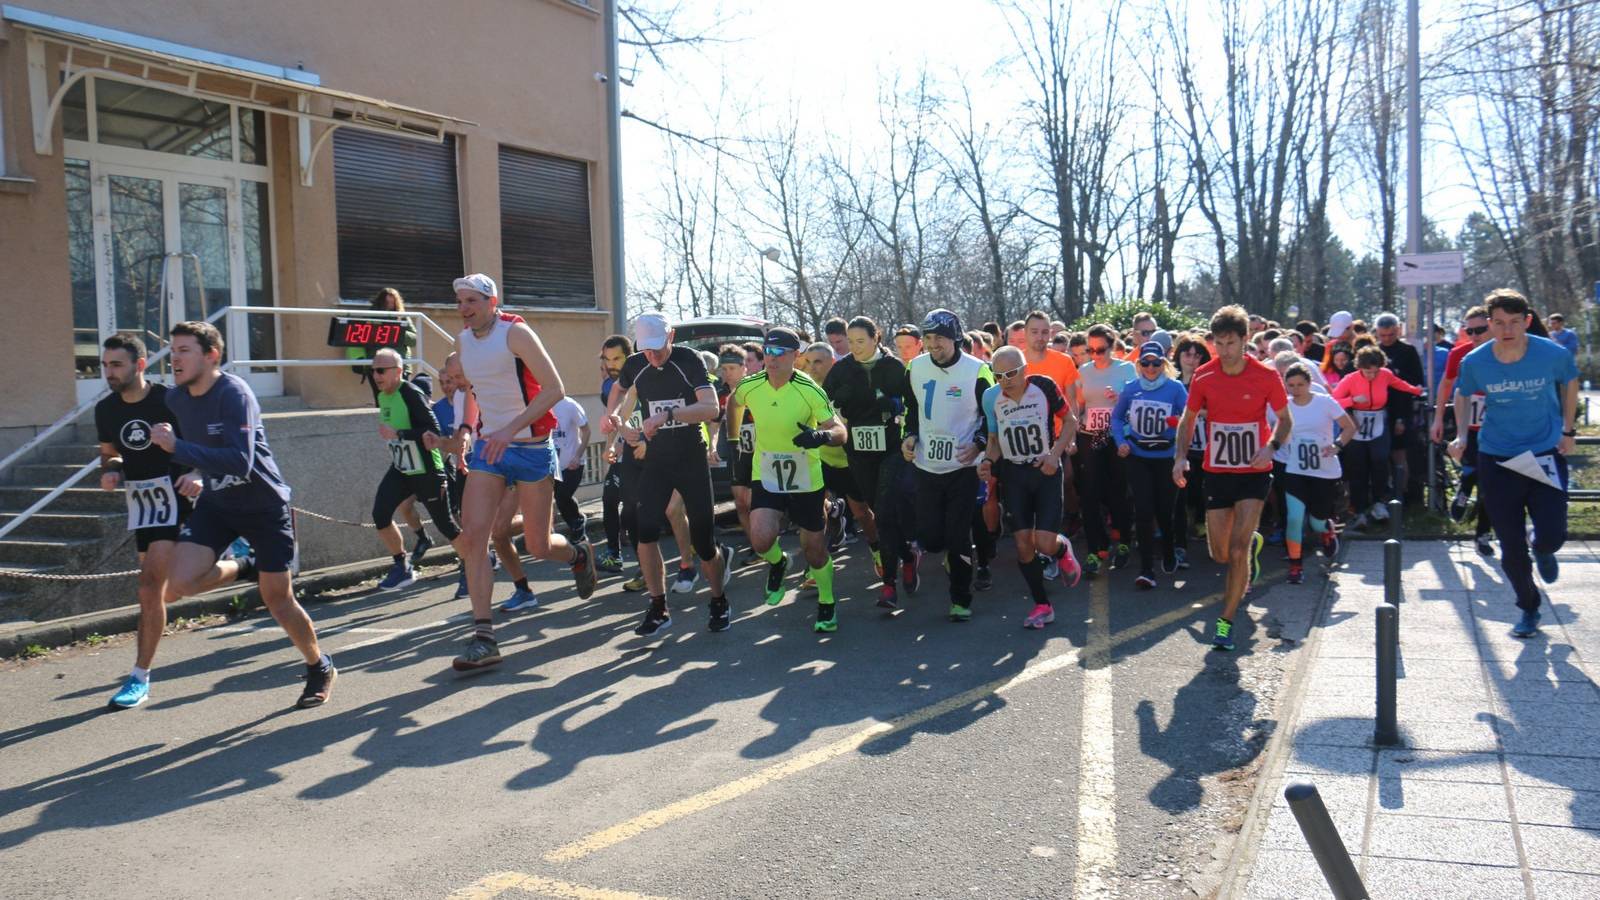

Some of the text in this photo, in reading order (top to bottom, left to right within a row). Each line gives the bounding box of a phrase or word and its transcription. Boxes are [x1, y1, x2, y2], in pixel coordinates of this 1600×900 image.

[922, 379, 937, 420] 1
[1091, 412, 1110, 430] 359
[1135, 406, 1166, 436] 166
[1360, 417, 1375, 439] 41
[857, 431, 880, 450] 381
[928, 439, 953, 461] 380
[1003, 423, 1044, 456] 103
[1214, 430, 1255, 466] 200
[1298, 443, 1320, 470] 98
[772, 459, 799, 491] 12
[132, 486, 171, 526] 113
